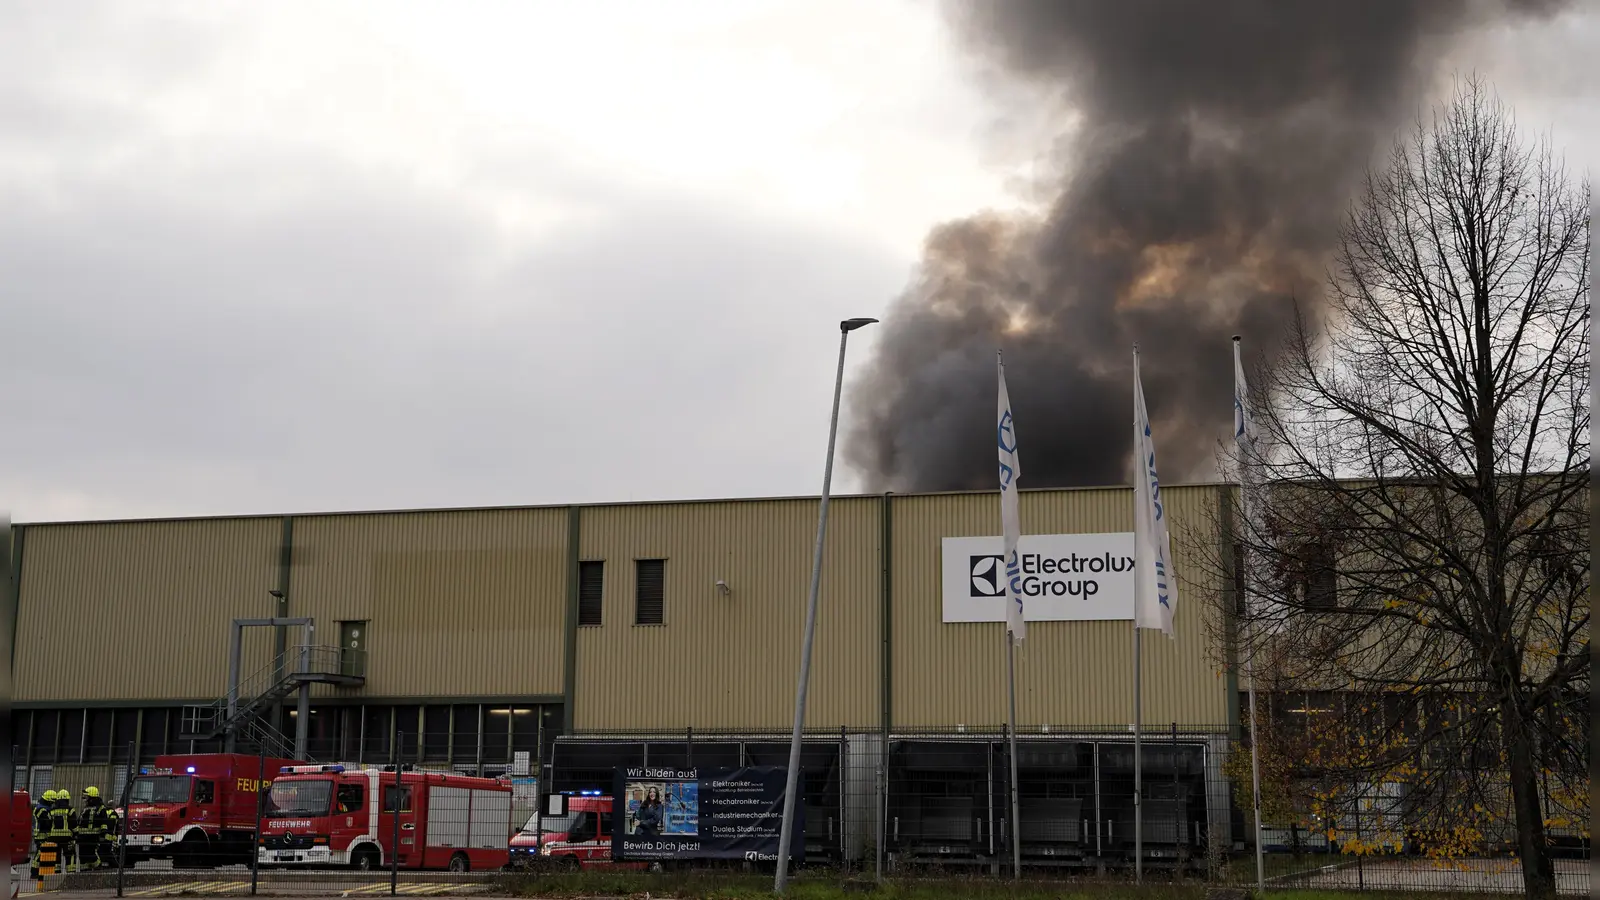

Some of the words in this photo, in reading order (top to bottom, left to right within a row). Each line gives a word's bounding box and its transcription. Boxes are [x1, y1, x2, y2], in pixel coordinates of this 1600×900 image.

[1022, 552, 1135, 574] Electrolux
[1022, 576, 1099, 601] Group
[627, 768, 643, 777] Wir
[645, 768, 675, 778] bilden
[677, 769, 698, 778] aus!
[712, 780, 751, 788] Elektroniker
[712, 811, 778, 819] Industriemechaniker
[268, 820, 312, 829] FEUERWEHR
[737, 825, 763, 833] Studium
[623, 841, 653, 850] Bewirb
[656, 841, 676, 850] Dich
[677, 842, 701, 852] jetzt!
[758, 853, 793, 861] Electrx
